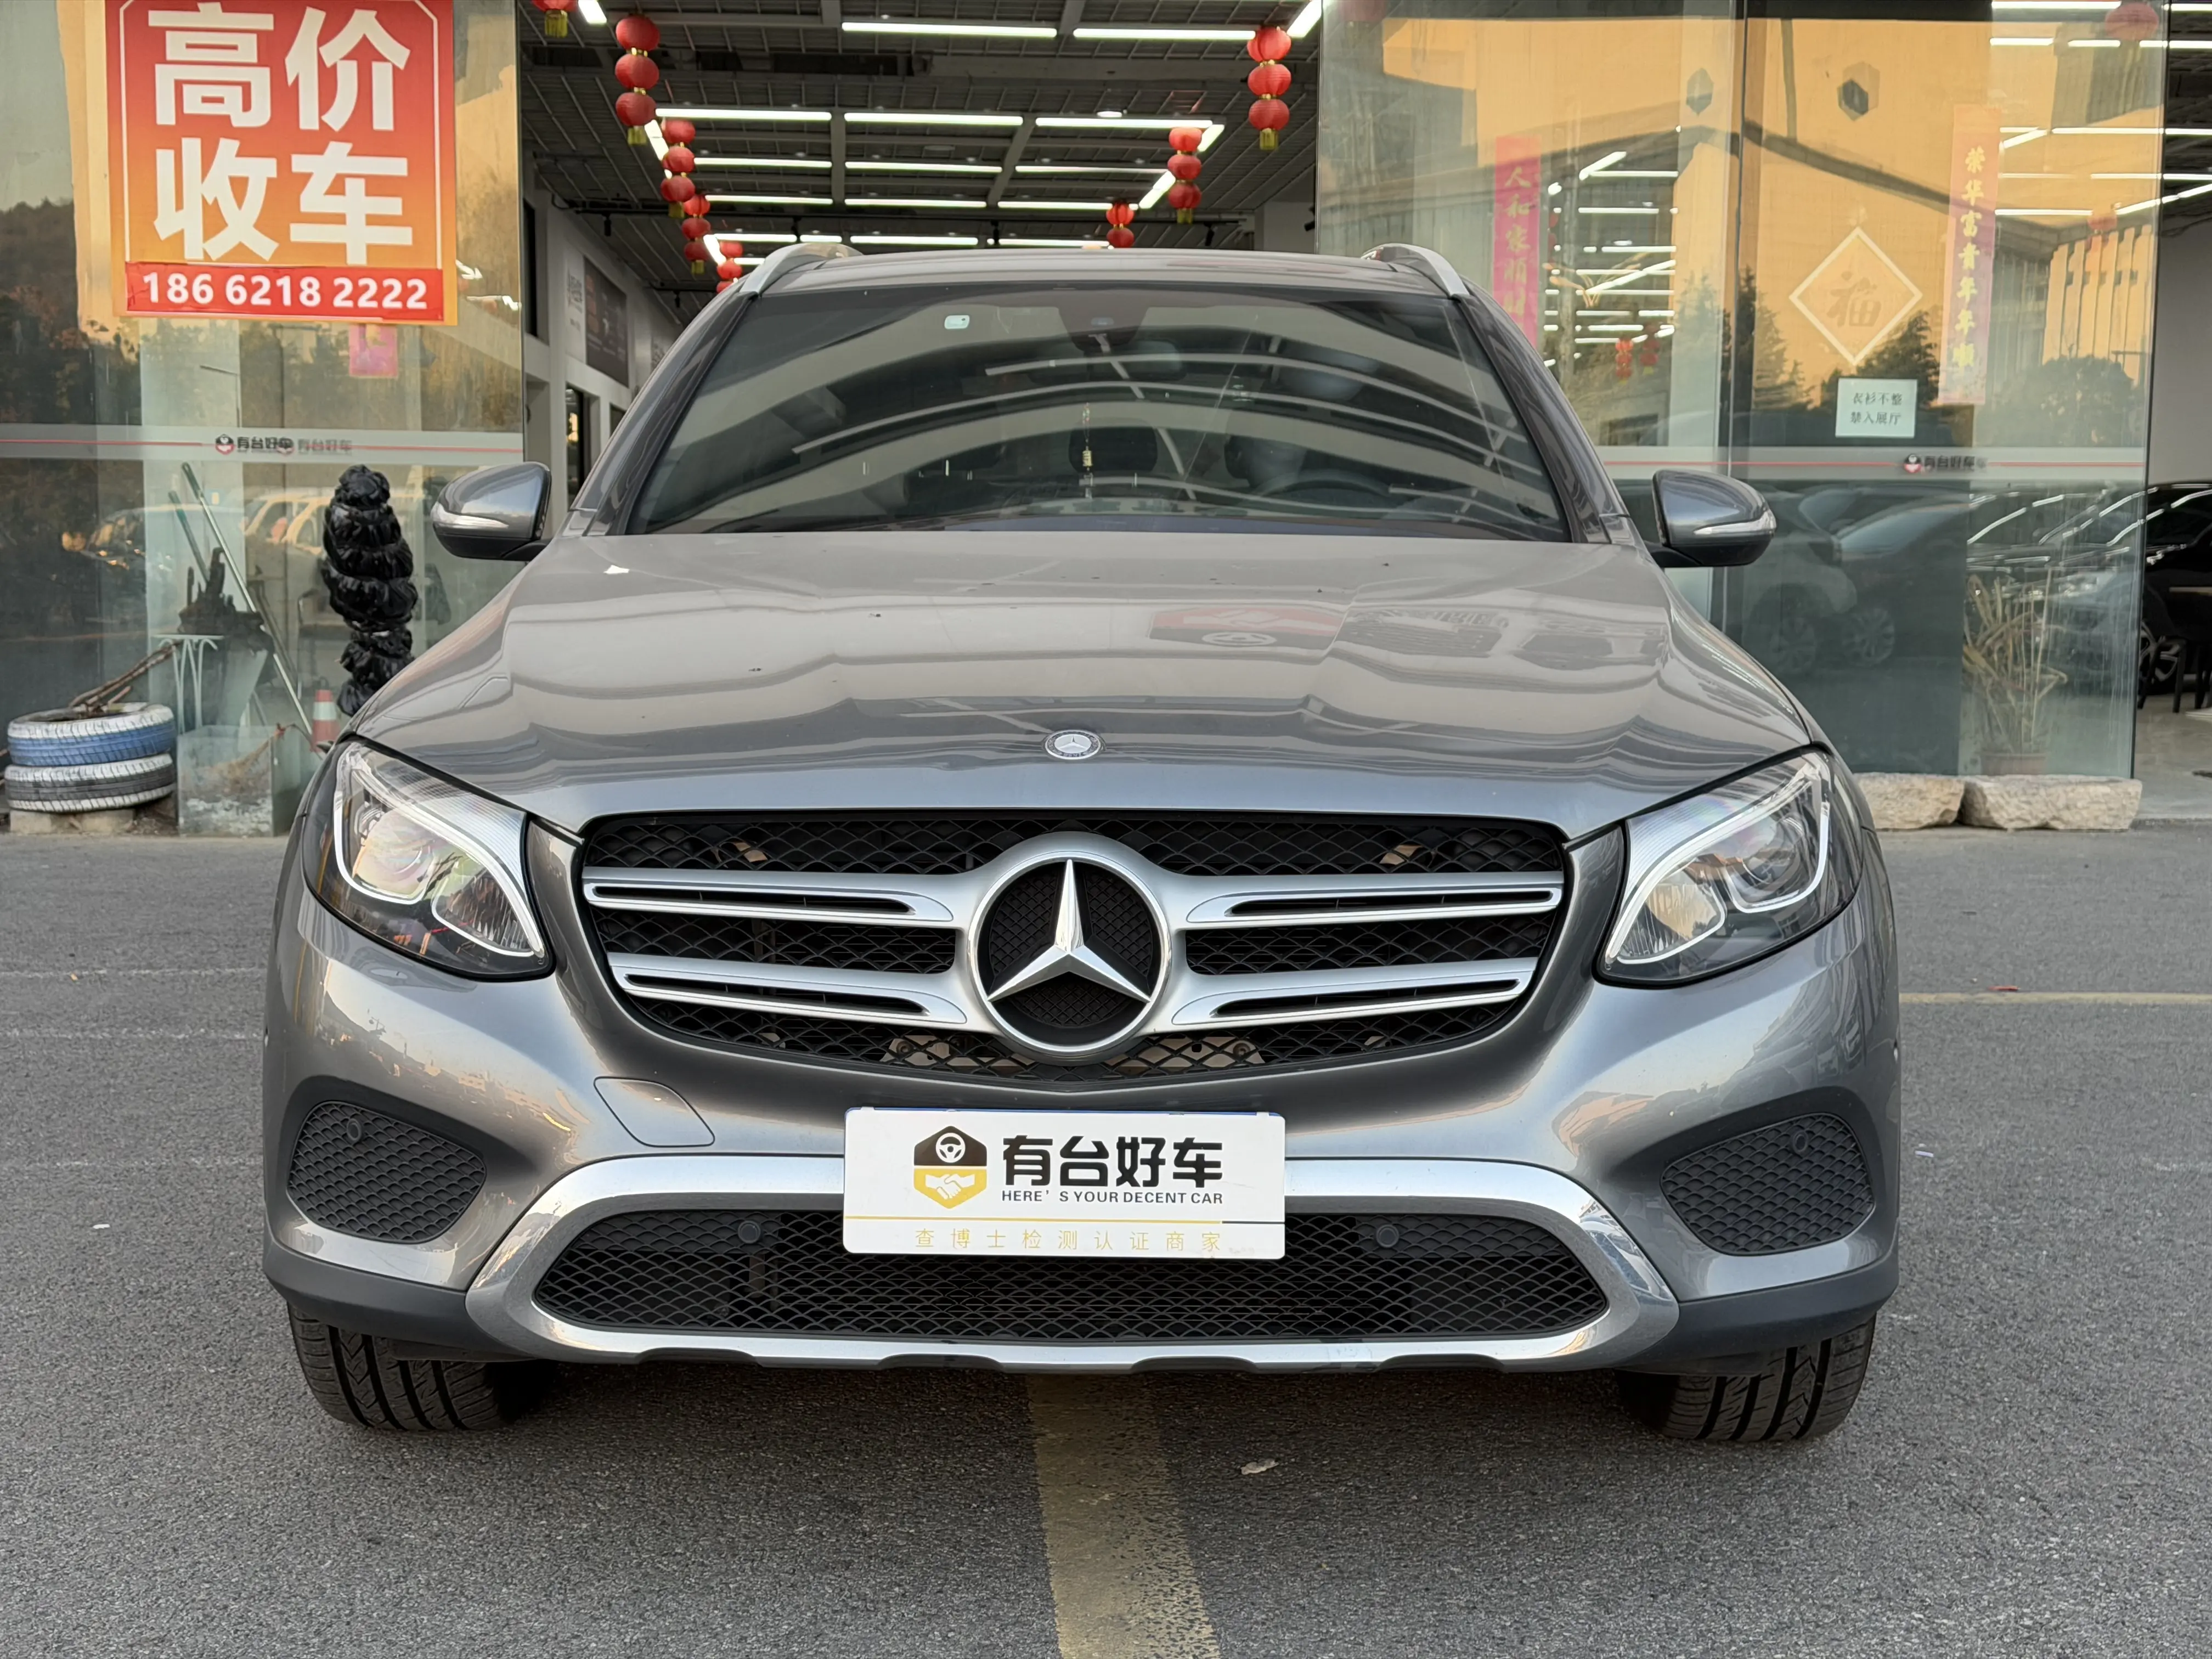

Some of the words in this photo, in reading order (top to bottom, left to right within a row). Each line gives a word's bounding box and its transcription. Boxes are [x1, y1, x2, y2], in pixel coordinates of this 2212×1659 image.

[148, 2, 411, 132] 高价
[154, 137, 413, 266] 收车
[143, 272, 214, 304] 186
[225, 274, 321, 307] 6218
[333, 278, 428, 309] 2222
[1826, 271, 1882, 328] 福
[1003, 1135, 1223, 1188] 有台好车
[1073, 1191, 1119, 1203] YOUR
[1123, 1192, 1187, 1204] DECENT
[1190, 1193, 1223, 1204] CAR
[915, 1228, 1221, 1252] 查博士检测认证商家
